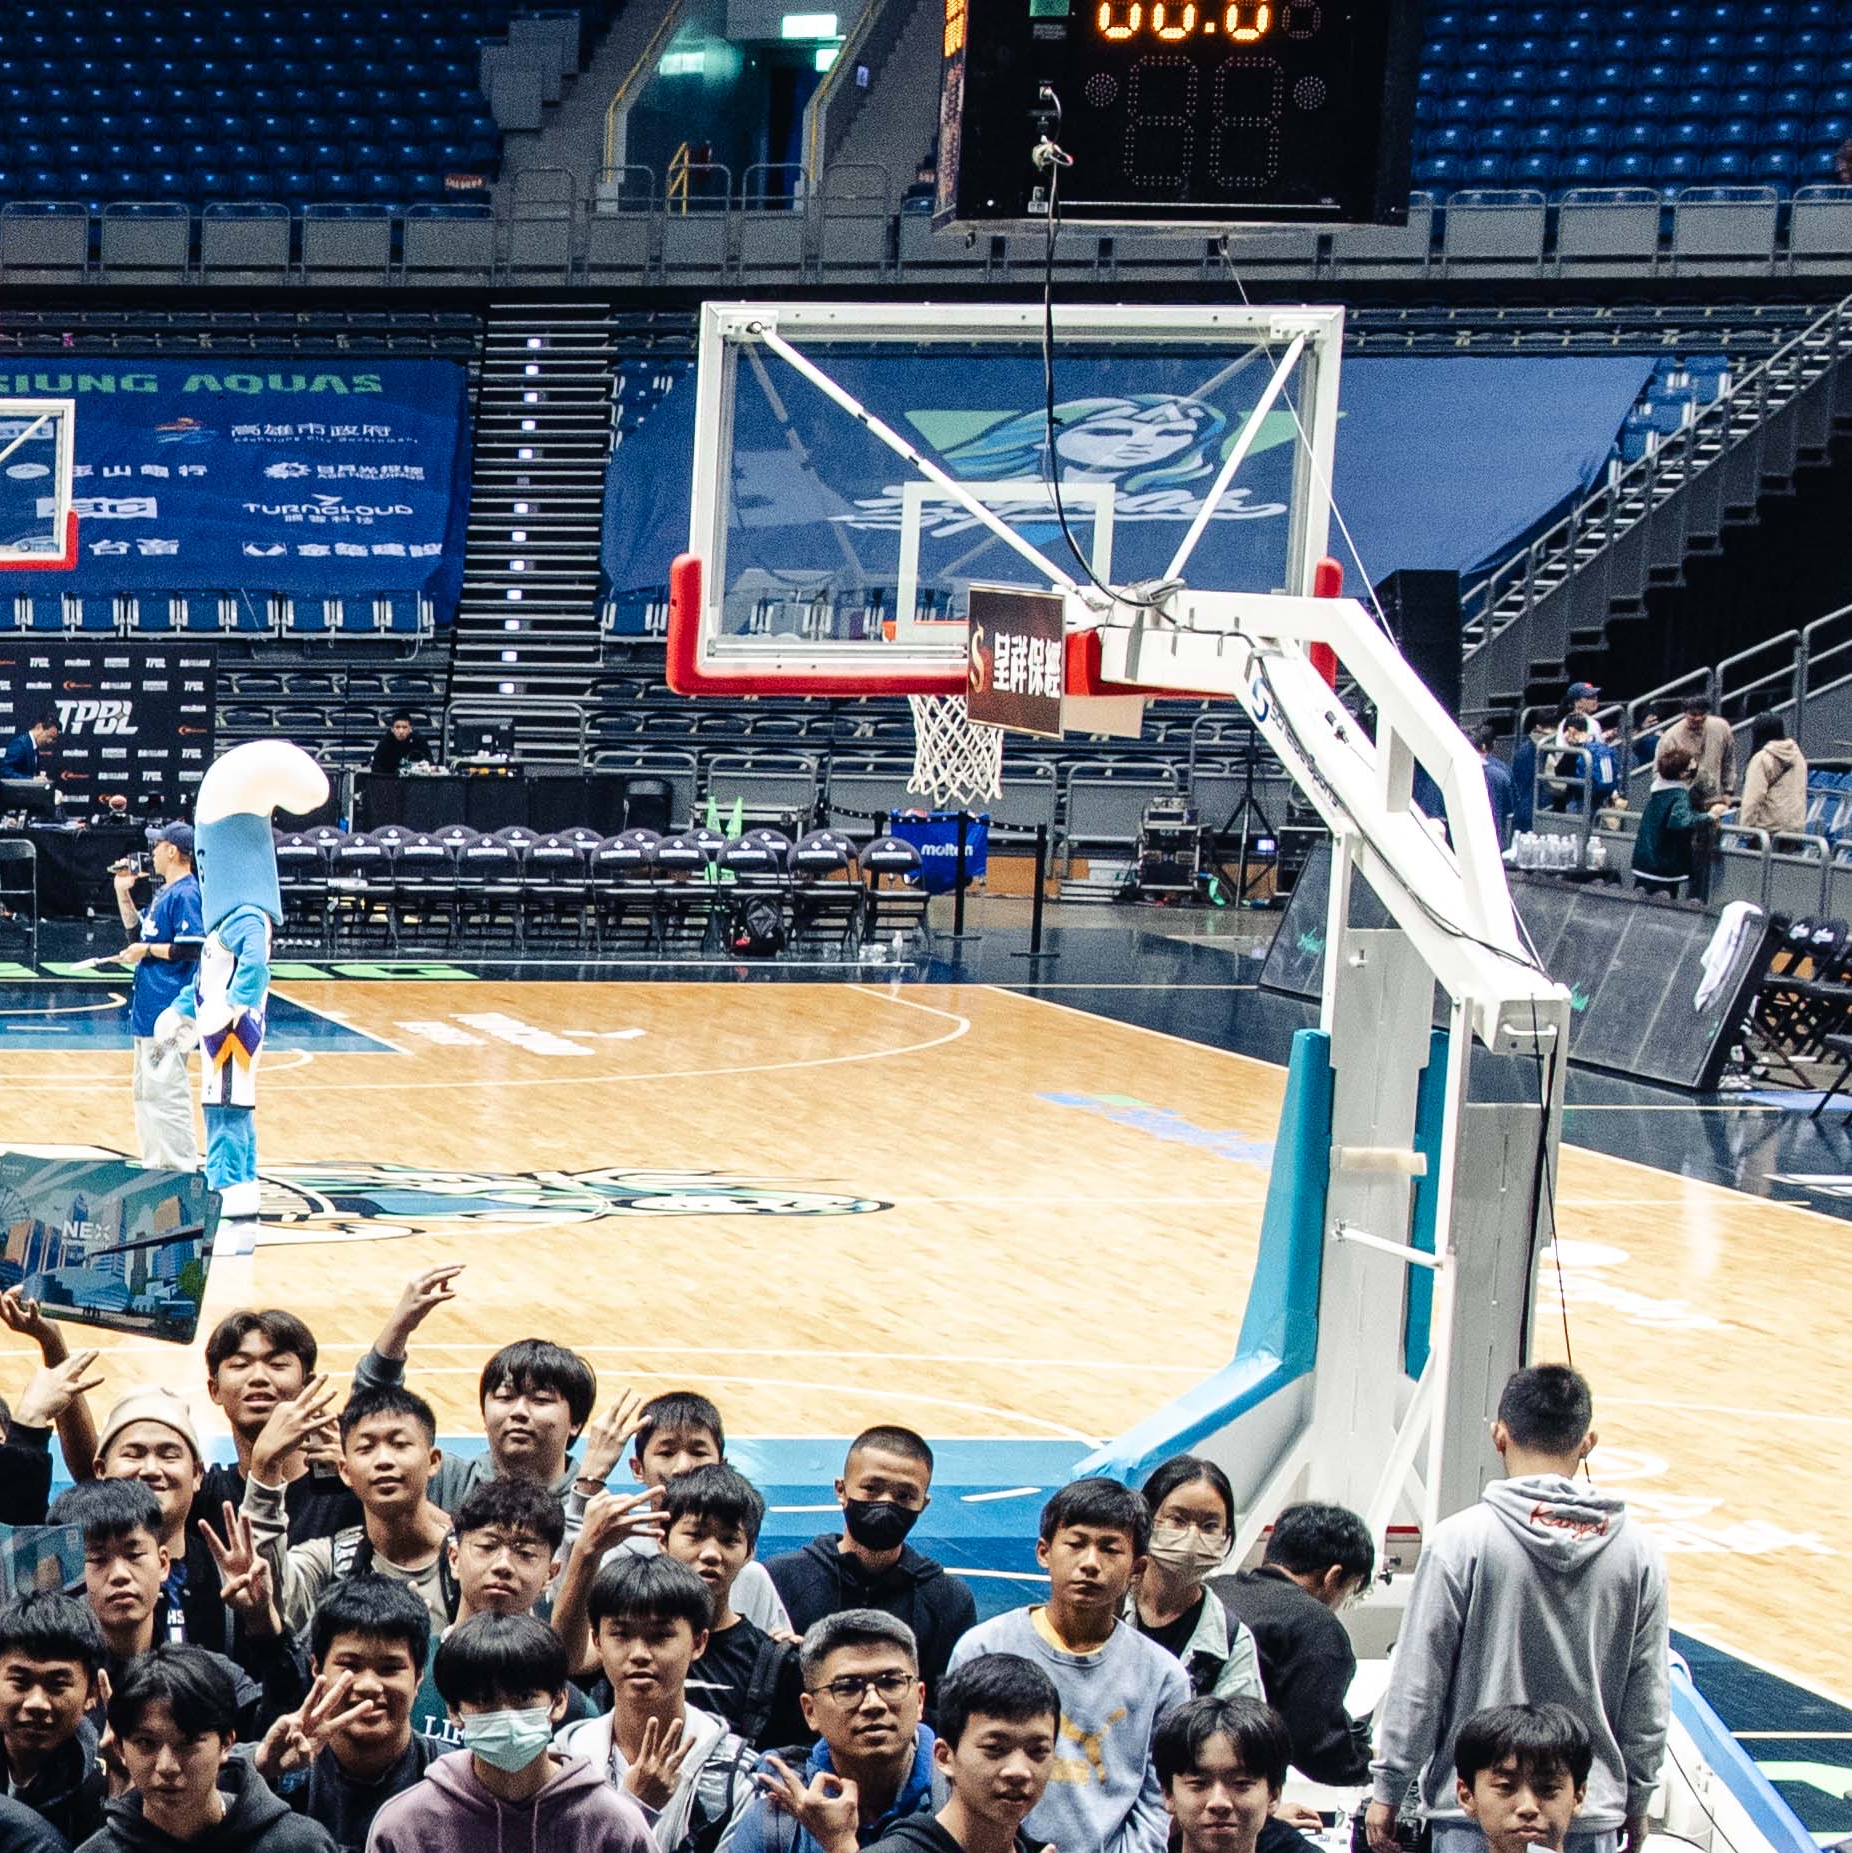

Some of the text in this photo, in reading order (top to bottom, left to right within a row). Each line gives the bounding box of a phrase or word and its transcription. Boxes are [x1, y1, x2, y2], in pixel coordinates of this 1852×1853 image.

[182, 374, 384, 394] AQUAS
[242, 502, 414, 516] TURNCLOUD
[55, 700, 140, 735] TPBL
[921, 844, 974, 857] moltn
